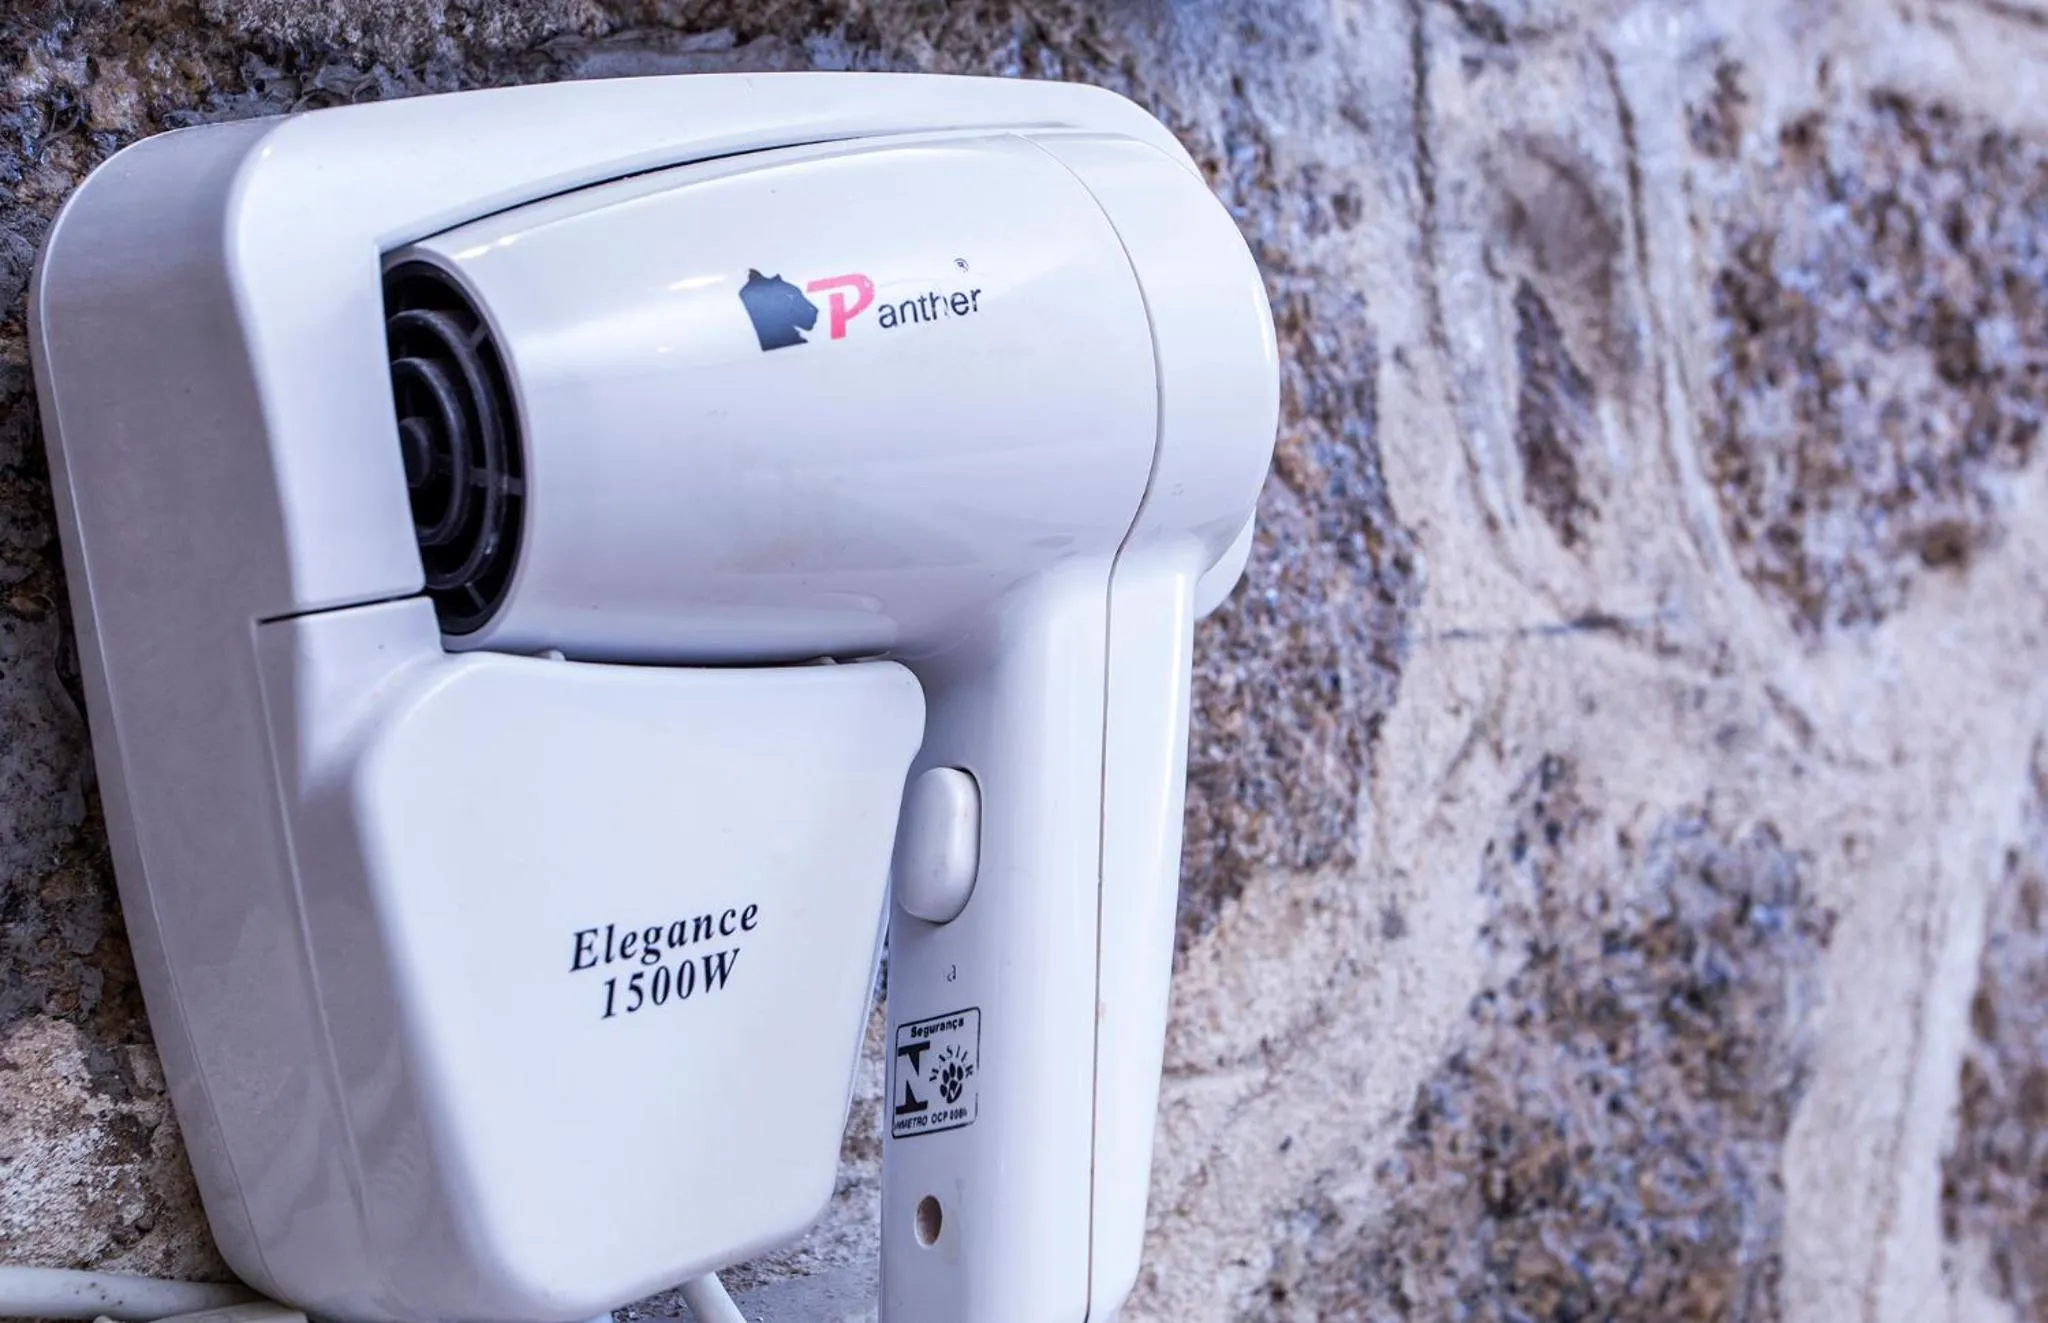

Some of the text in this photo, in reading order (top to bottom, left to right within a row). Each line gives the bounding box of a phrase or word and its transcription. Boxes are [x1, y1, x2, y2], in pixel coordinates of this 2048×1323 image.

[569, 903, 759, 973] Elegance
[601, 947, 740, 1020] 1500W
[911, 1017, 964, 1038] Segurança
[894, 1115, 928, 1130] NMETRO
[931, 1110, 948, 1124] OCP
